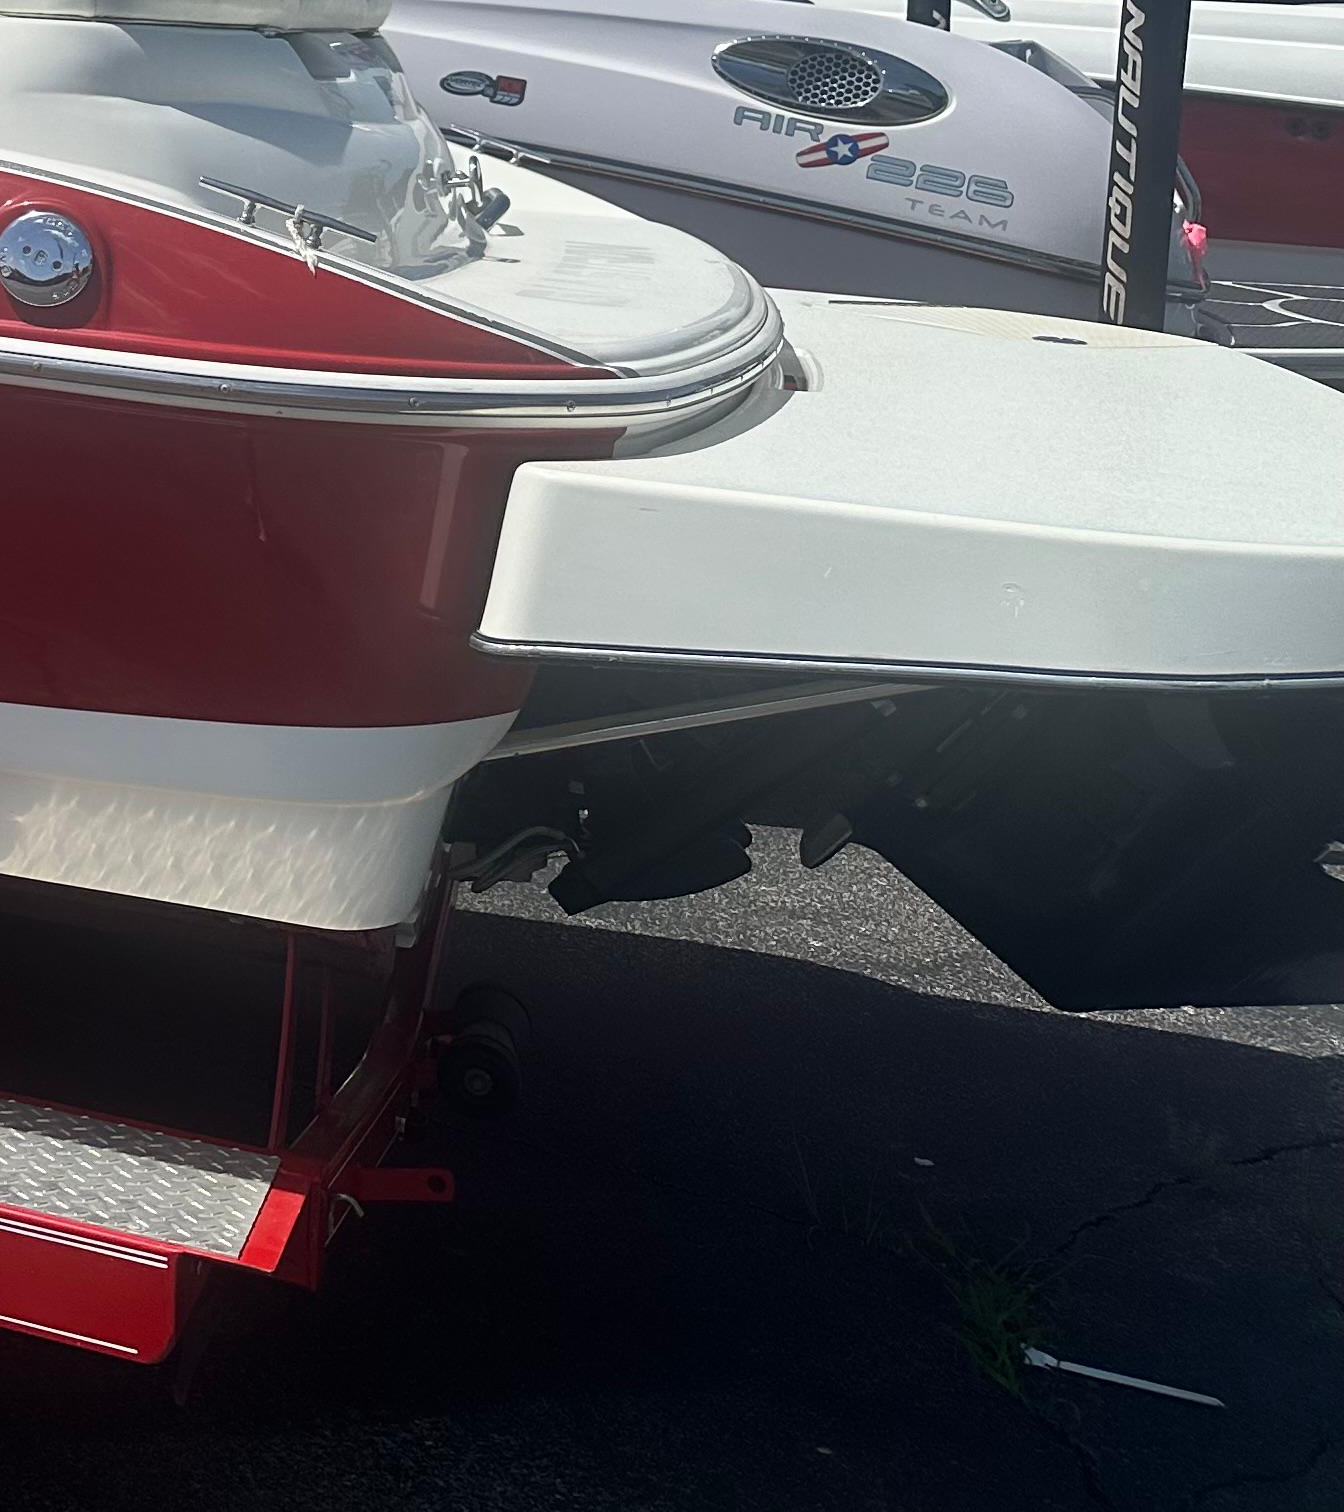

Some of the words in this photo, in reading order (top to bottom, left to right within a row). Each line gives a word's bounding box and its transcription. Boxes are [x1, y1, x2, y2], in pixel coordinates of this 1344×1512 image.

[733, 106, 824, 142] AIR
[866, 154, 1014, 208] 226
[905, 197, 1009, 232] TEAM
